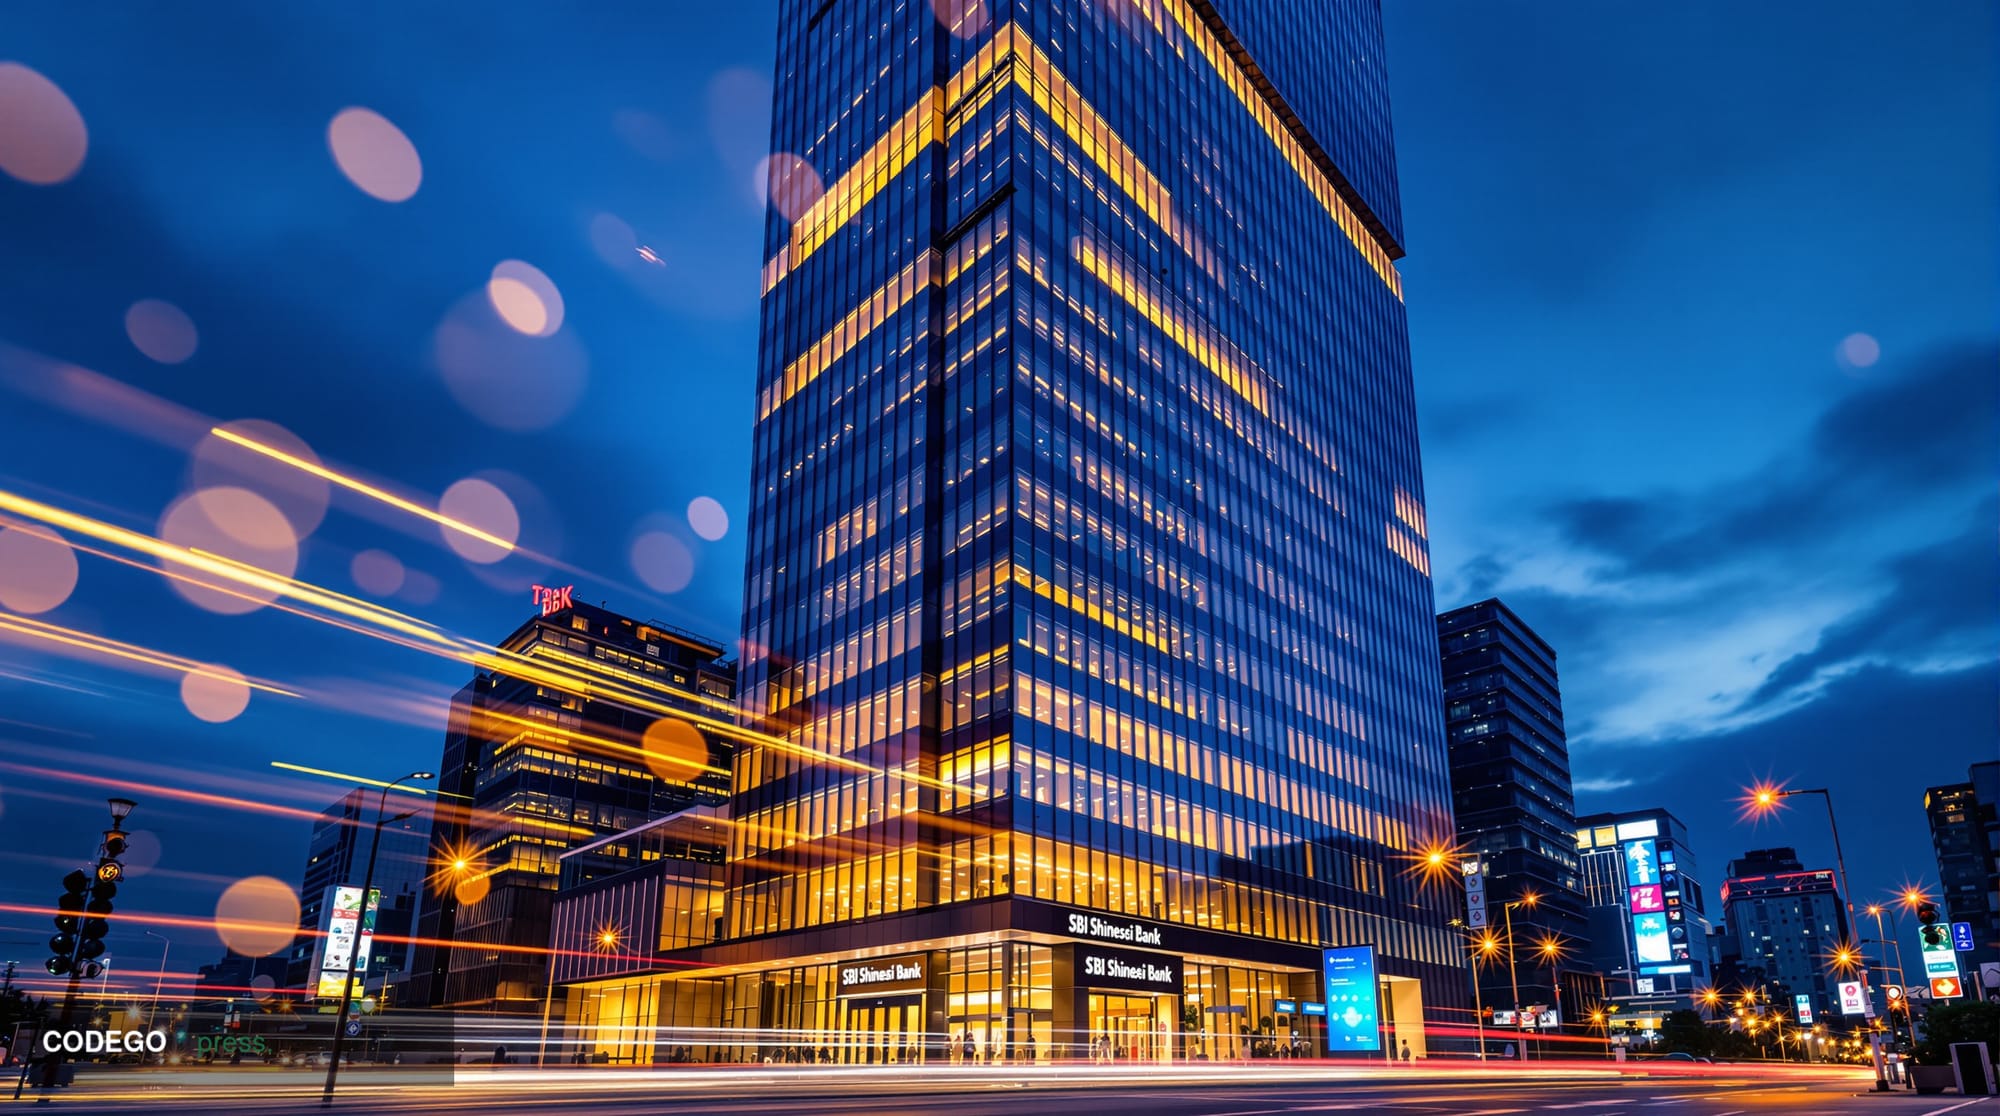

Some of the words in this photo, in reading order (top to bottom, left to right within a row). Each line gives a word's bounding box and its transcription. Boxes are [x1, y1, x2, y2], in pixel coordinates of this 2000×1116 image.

[1068, 913, 1088, 934] SBI
[1135, 925, 1161, 945] Bank
[842, 968, 858, 986] SBI
[896, 962, 922, 980] Bank
[1085, 956, 1105, 976] SBI
[1147, 964, 1172, 983] Bank
